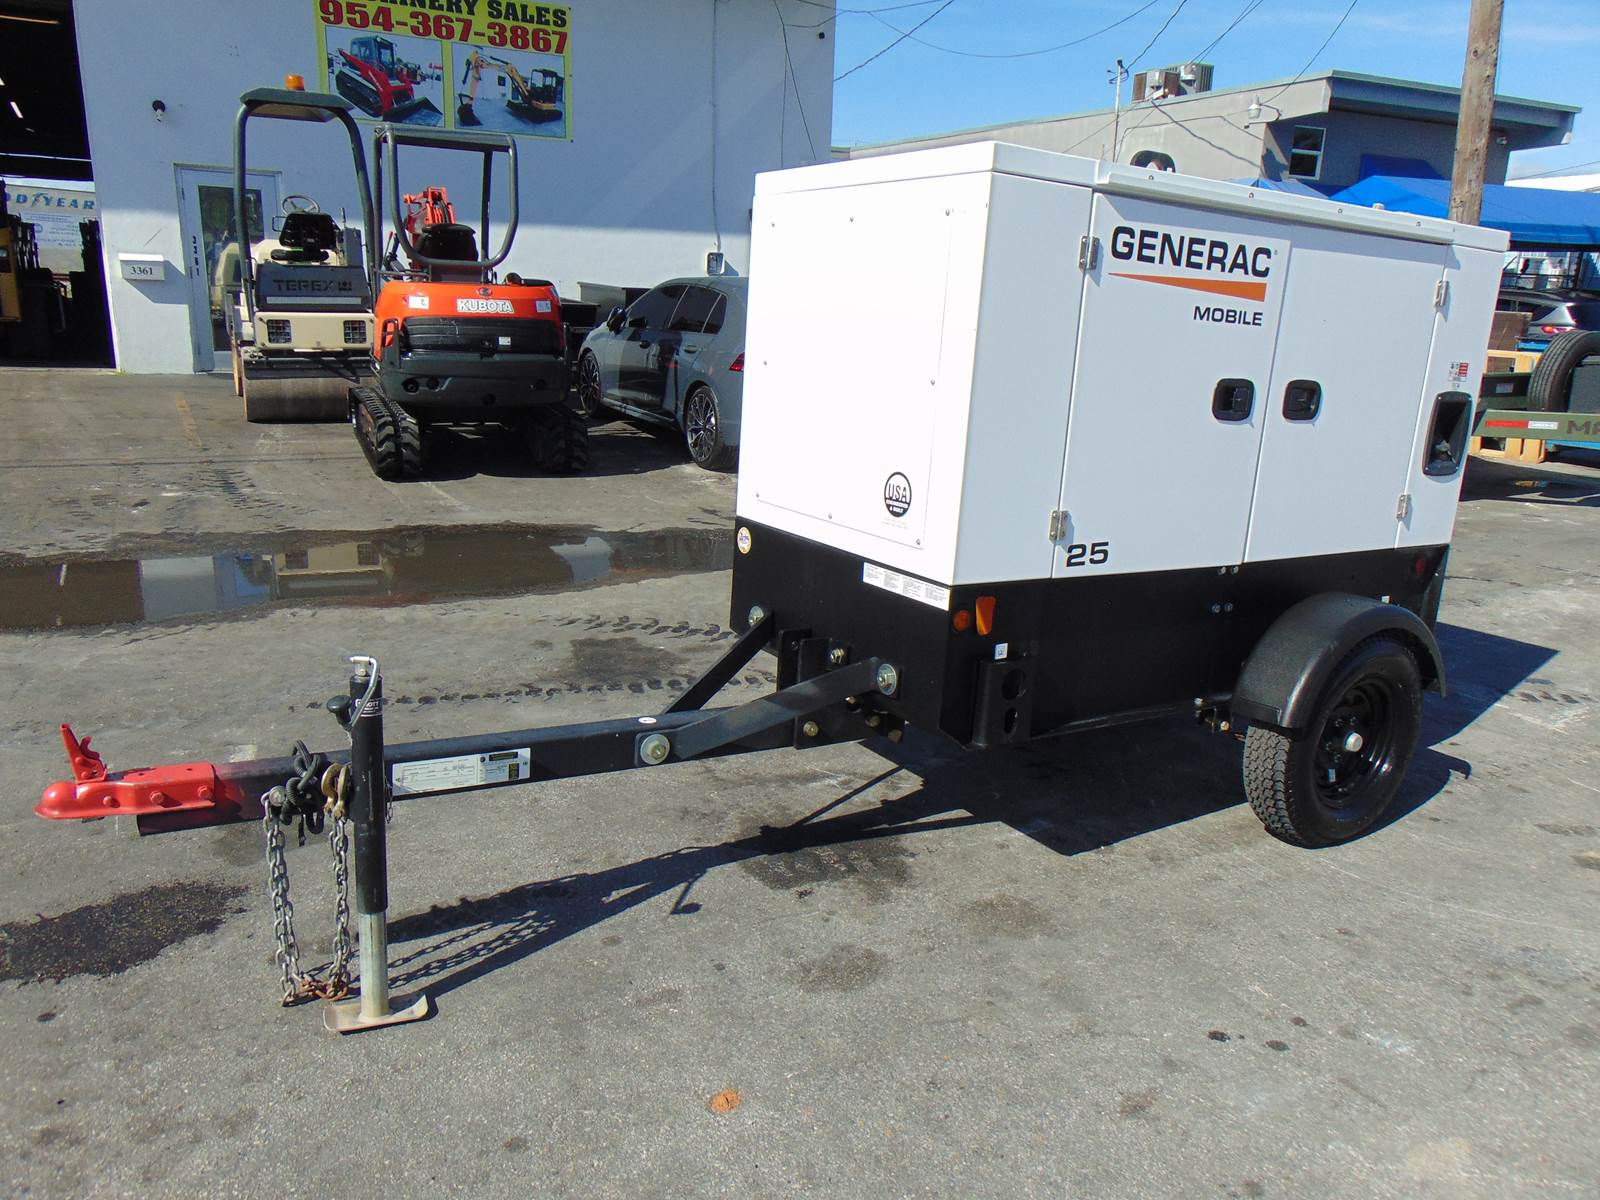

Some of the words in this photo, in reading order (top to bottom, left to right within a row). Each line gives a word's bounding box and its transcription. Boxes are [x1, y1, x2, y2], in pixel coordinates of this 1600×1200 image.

[488, 0, 567, 28] SALES
[319, 0, 568, 54] 954-367-3867
[1111, 226, 1272, 278] GENERAC
[130, 266, 153, 275] 3361
[457, 299, 514, 313] KUBOTA
[1193, 306, 1263, 326] MOBILE
[888, 483, 908, 503] USA
[1066, 541, 1109, 567] 25
